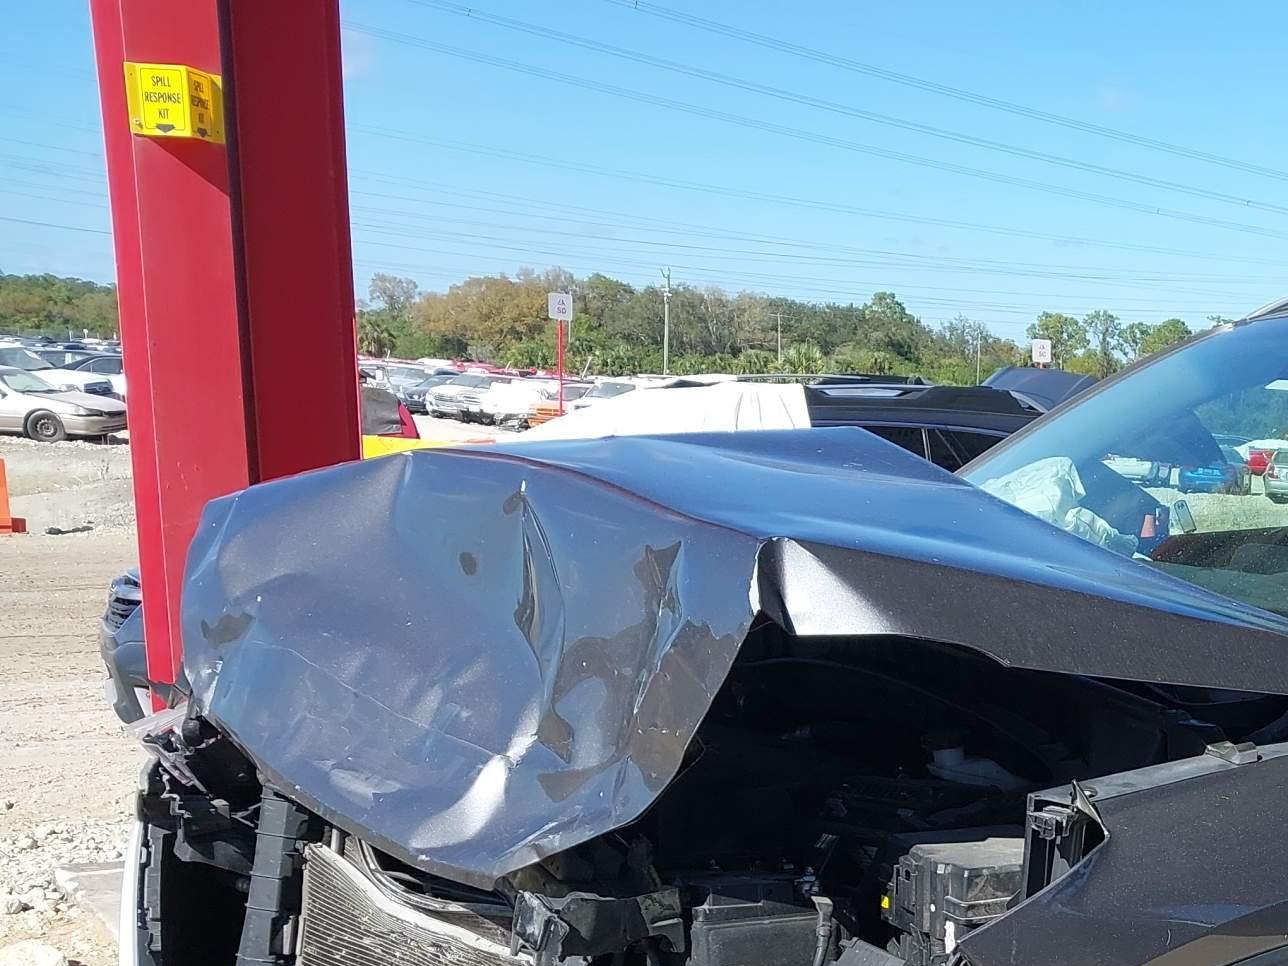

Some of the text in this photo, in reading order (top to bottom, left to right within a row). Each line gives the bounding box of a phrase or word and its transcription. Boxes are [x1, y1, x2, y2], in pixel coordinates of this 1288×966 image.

[151, 75, 171, 88] SPILL
[144, 91, 182, 104] RESPONSE
[158, 108, 170, 119] KIT
